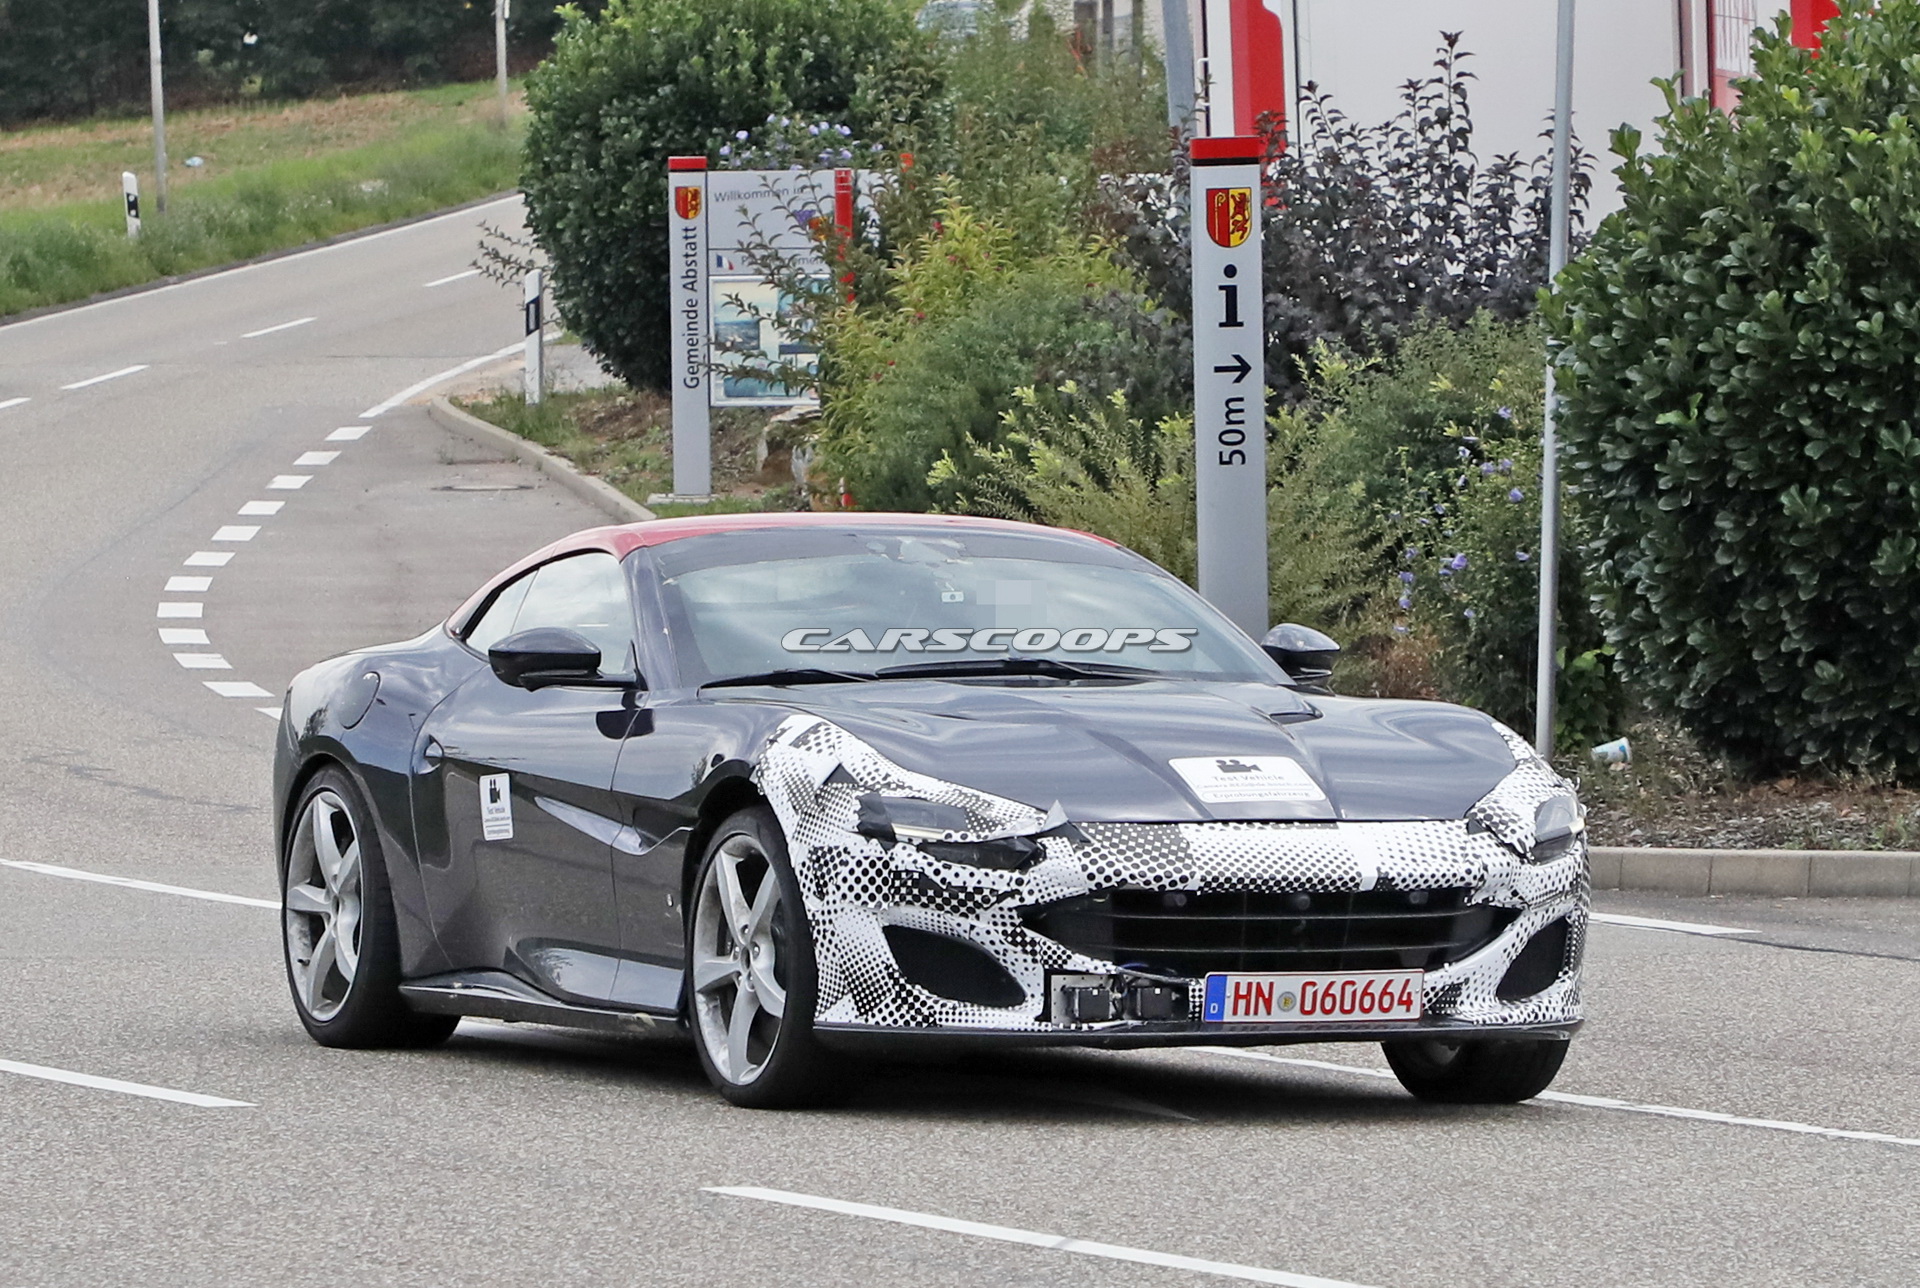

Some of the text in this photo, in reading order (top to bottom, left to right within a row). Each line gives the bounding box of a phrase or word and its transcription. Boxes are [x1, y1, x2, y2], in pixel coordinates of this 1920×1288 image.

[682, 226, 700, 389] Gemeinde Abstatt
[1218, 263, 1244, 328] i
[1218, 396, 1246, 466] 50m
[1212, 775, 1239, 783] Test
[1209, 978, 1414, 1016] D HN 060664
